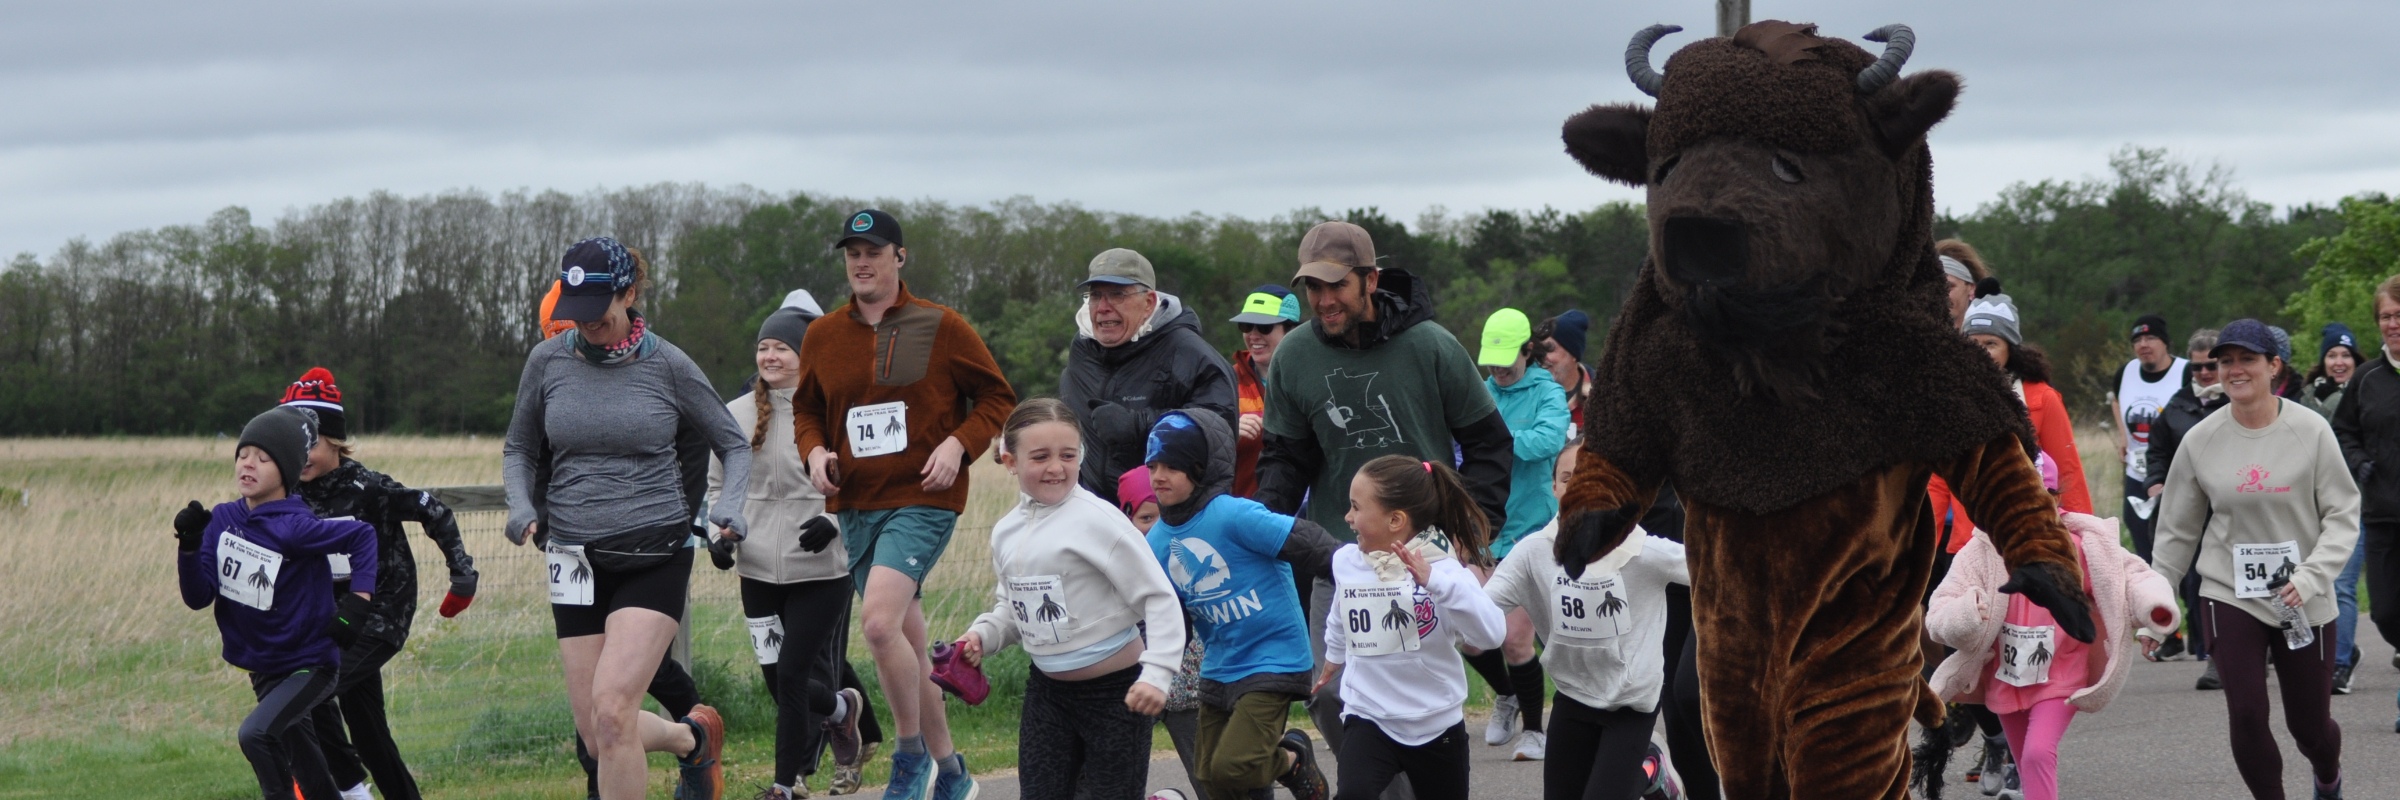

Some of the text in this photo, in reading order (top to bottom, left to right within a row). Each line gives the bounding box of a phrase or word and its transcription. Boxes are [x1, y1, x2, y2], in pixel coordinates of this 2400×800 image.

[857, 424, 875, 441] 74
[224, 538, 237, 549] 5K
[246, 551, 259, 560] TRAIL
[222, 556, 242, 580] 67
[2244, 563, 2267, 581] 54
[224, 585, 240, 595] BELWIN
[1557, 577, 1571, 587] 5K
[1344, 588, 1357, 598] 5K
[1012, 600, 1028, 623] 53
[1561, 595, 1585, 619] 58
[1348, 608, 1371, 633] 60
[2002, 626, 2011, 636] 5K
[2004, 644, 2018, 667] 52
